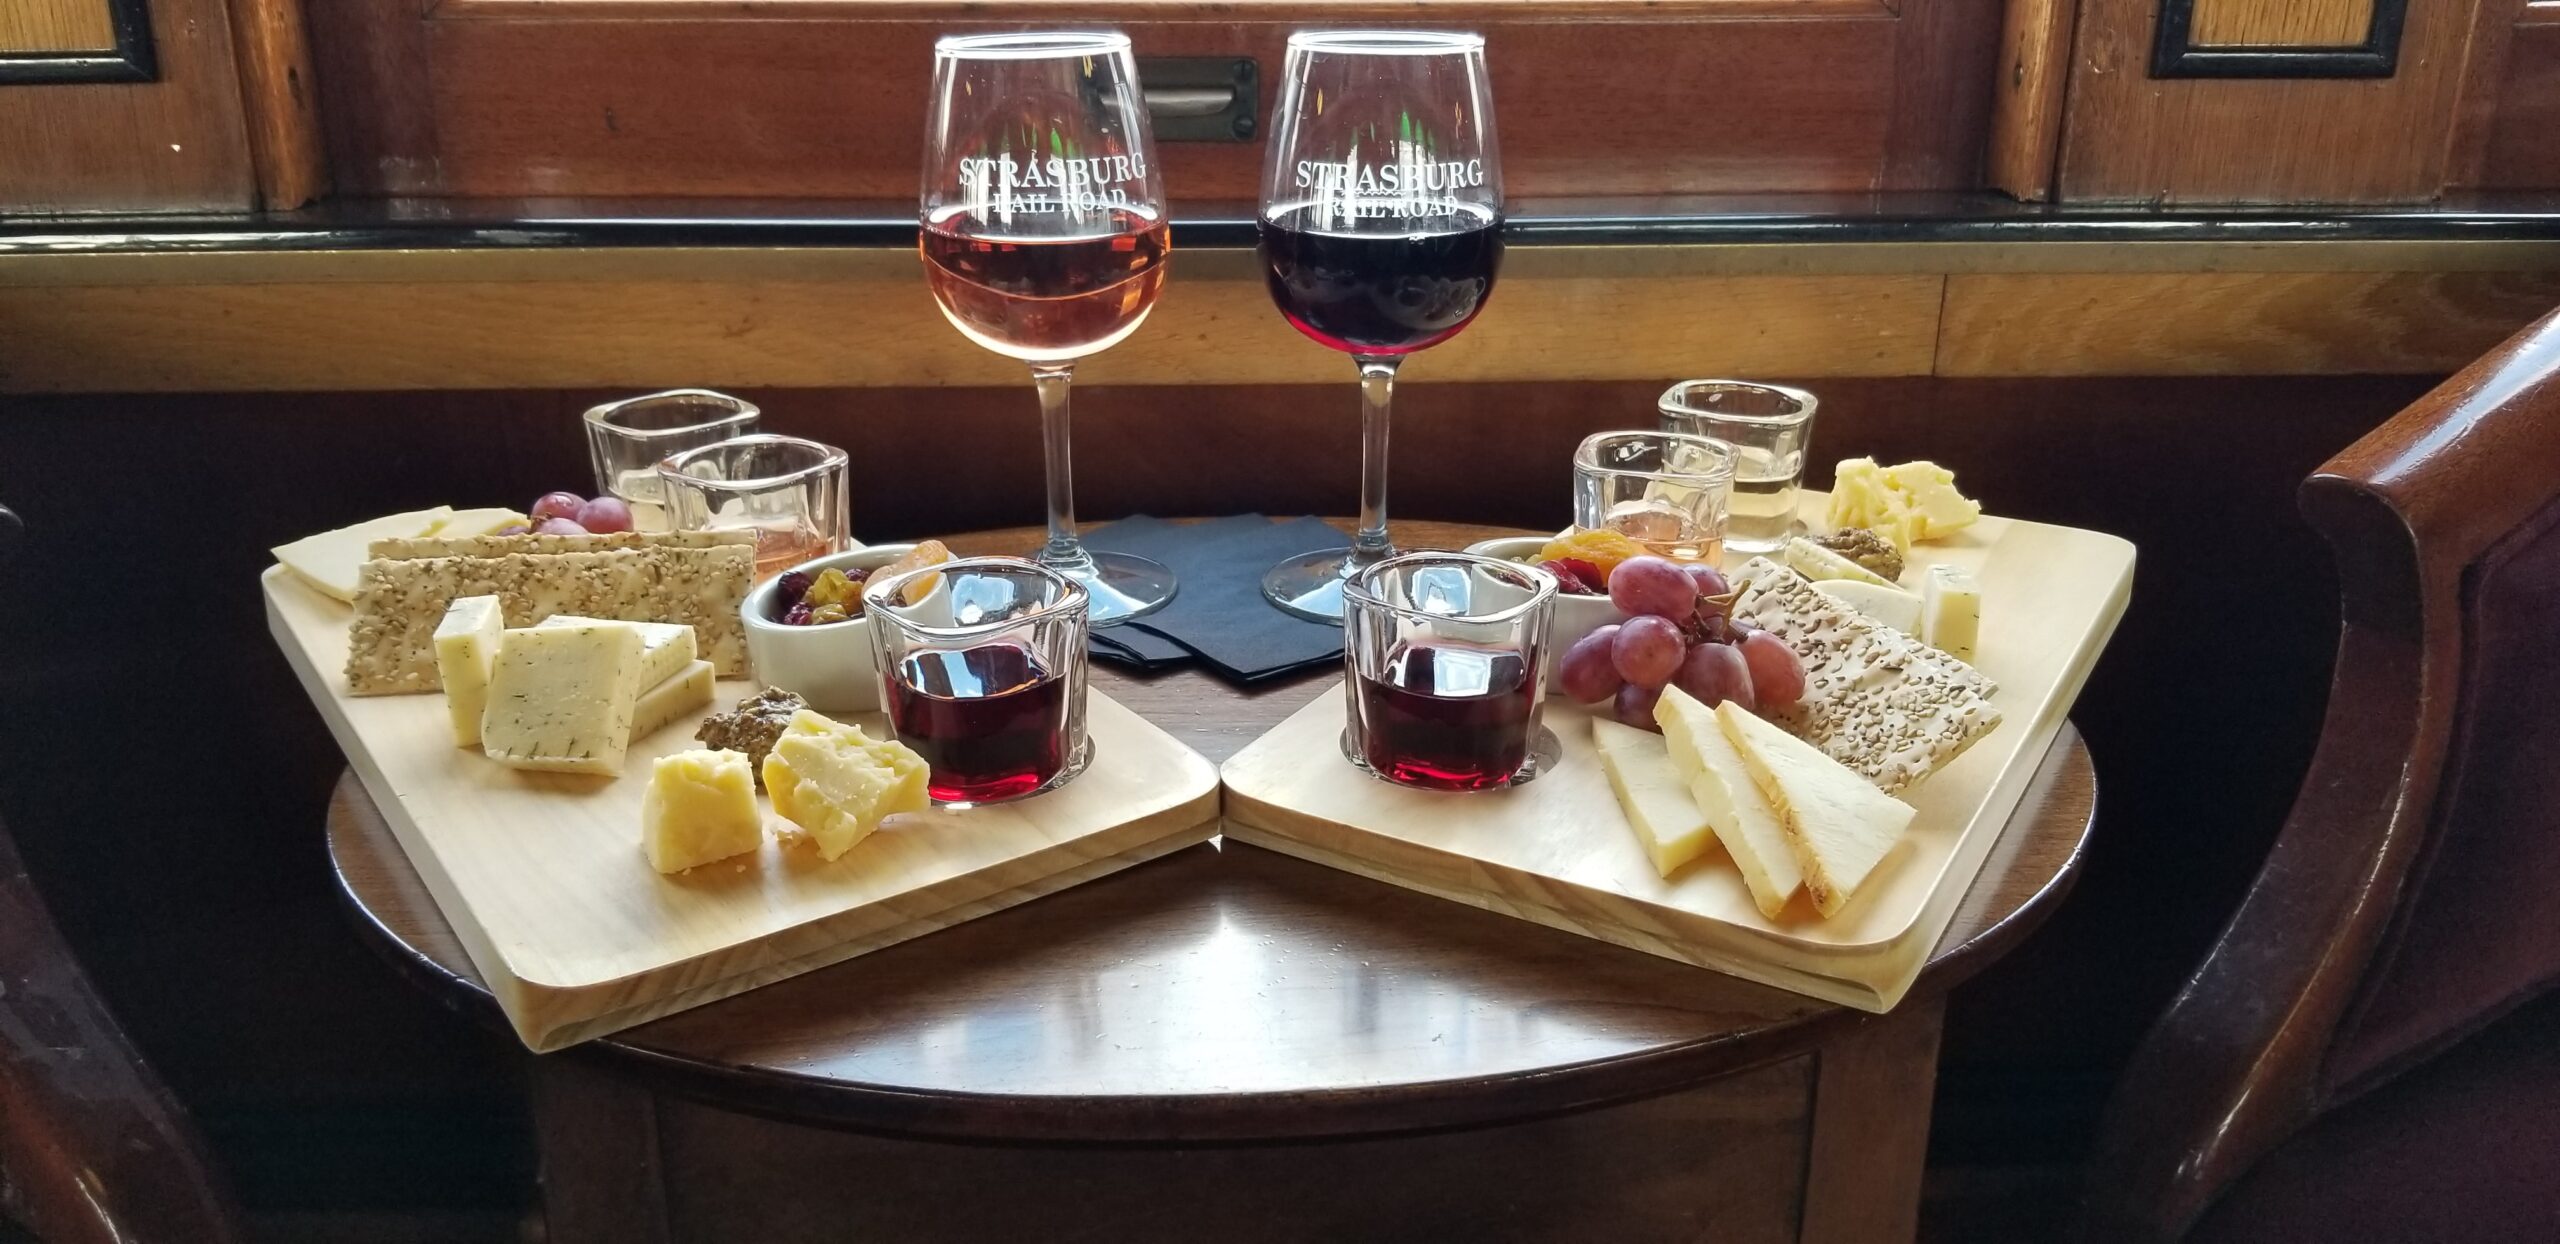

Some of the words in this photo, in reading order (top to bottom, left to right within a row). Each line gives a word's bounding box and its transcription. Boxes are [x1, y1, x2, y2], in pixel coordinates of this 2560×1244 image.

[959, 152, 1147, 188] STRASBURG
[1295, 159, 1484, 192] STRASBURG
[1392, 195, 1458, 218] ROAD
